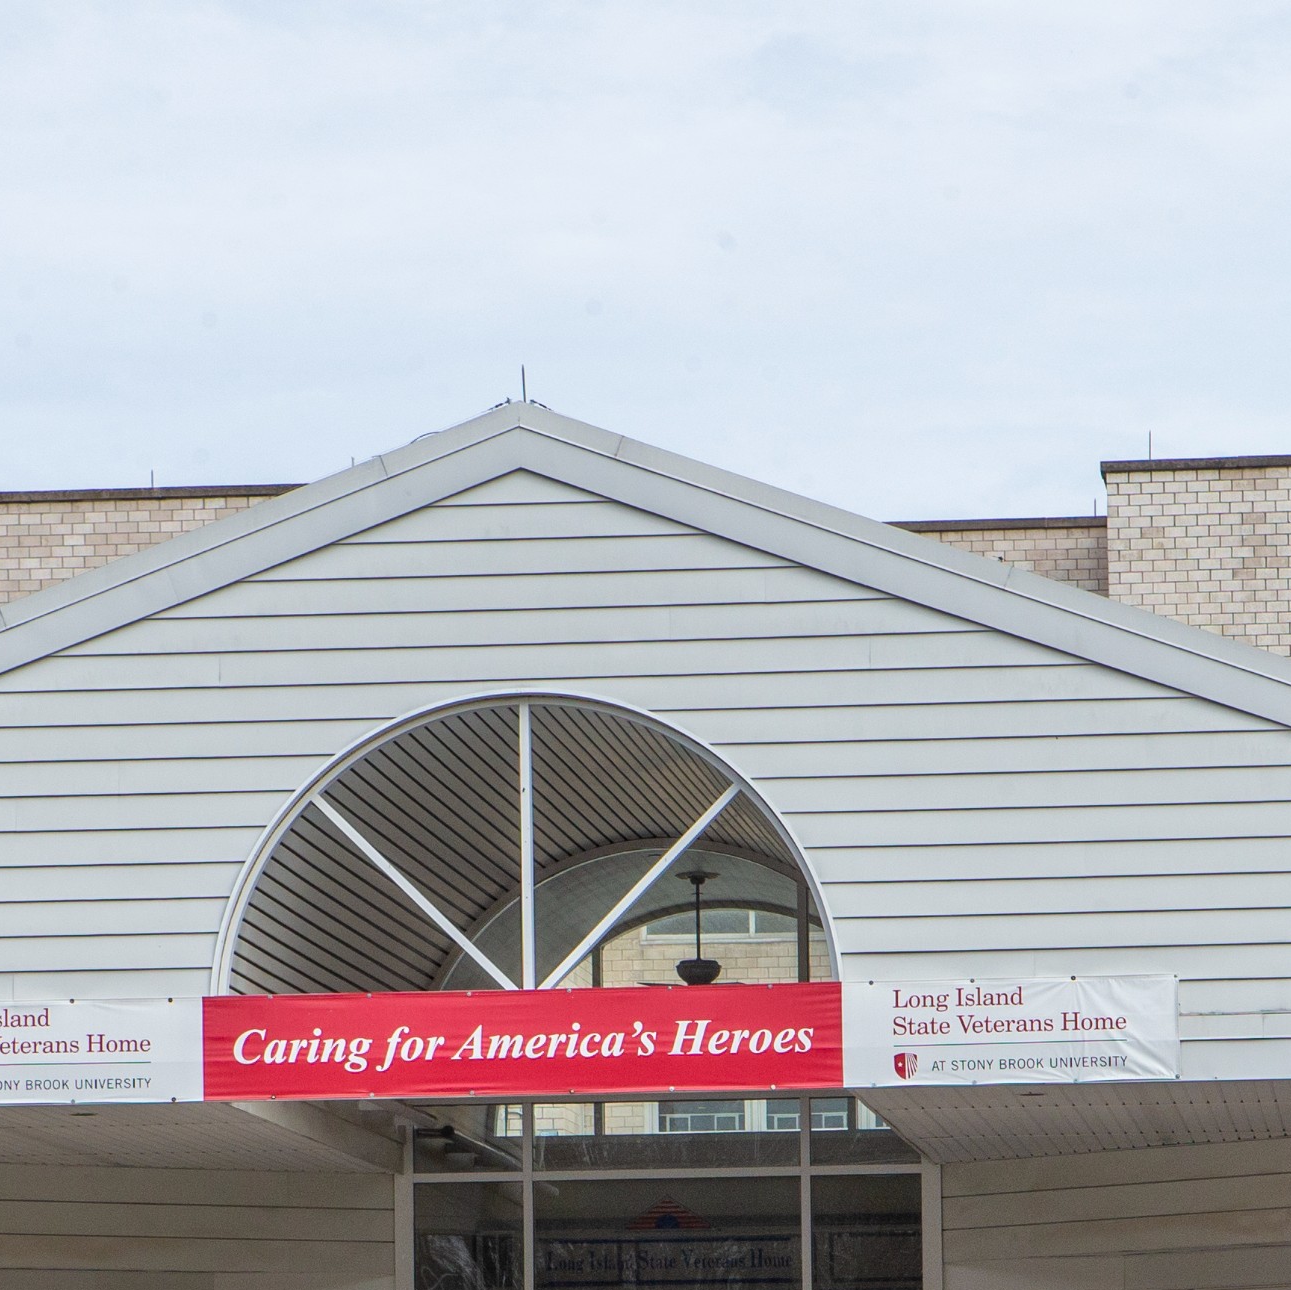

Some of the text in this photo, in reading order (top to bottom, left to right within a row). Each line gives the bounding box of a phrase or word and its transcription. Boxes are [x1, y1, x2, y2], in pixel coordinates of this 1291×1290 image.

[892, 986, 1024, 1012] Long Island
[893, 1012, 1127, 1036] State Veterans Home
[86, 1034, 151, 1053] Home
[233, 1019, 814, 1073] Caring for America’s Heroes
[931, 1055, 1128, 1072] AT STONY BROOK UNIVERSITY
[25, 1078, 70, 1090] BROOK
[74, 1077, 152, 1090] UNIVERSITY
[545, 1251, 584, 1273] Long
[637, 1249, 676, 1269] State
[750, 1248, 793, 1268] Home
